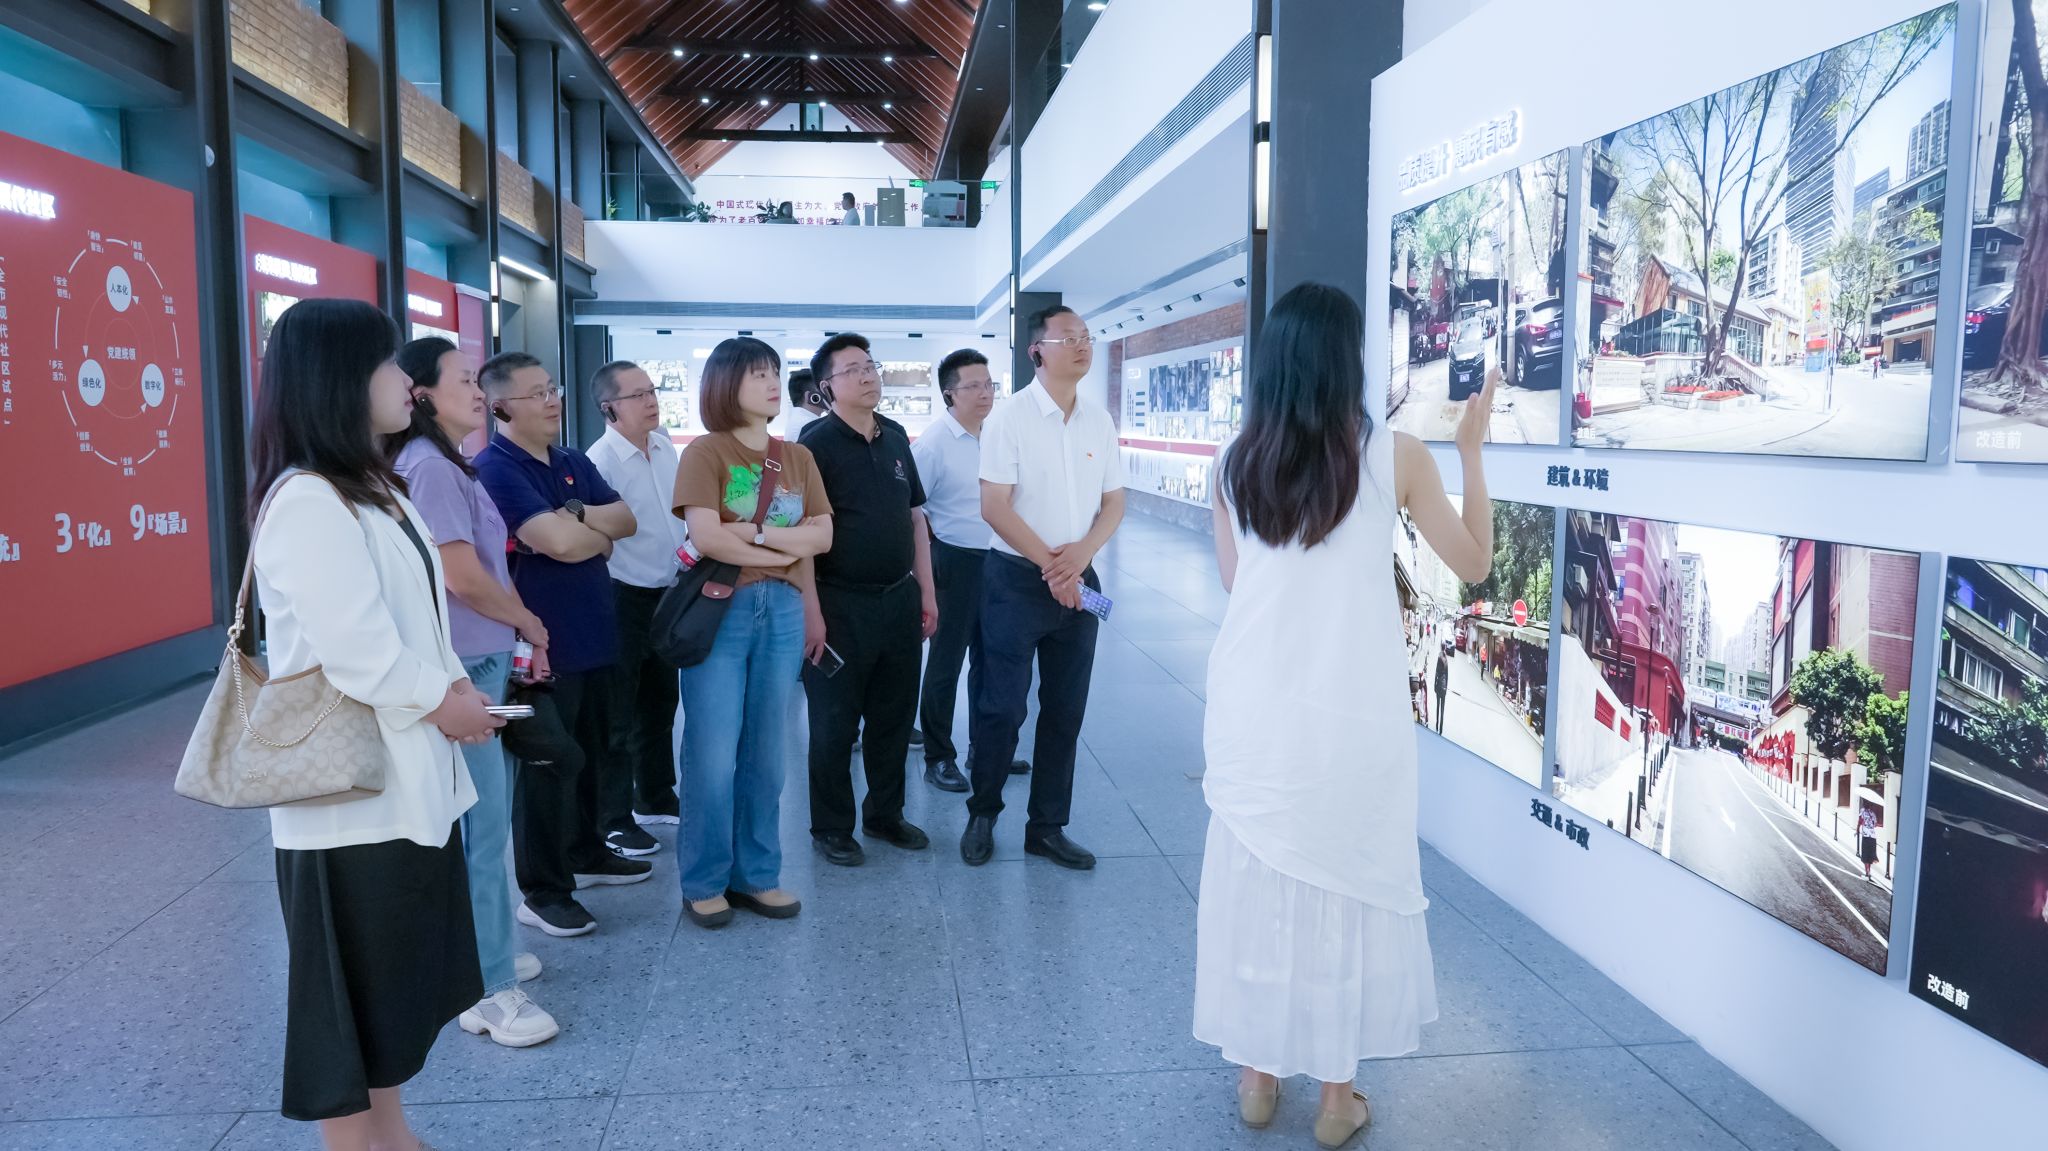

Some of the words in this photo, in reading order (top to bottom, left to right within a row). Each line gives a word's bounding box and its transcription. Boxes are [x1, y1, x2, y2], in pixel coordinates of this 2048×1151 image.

[110, 282, 129, 296] 人本化
[82, 377, 102, 389] 绿色化
[1976, 431, 2022, 449] 改造前
[1583, 468, 1609, 491] 环境
[1927, 973, 1970, 1010] 改造前
